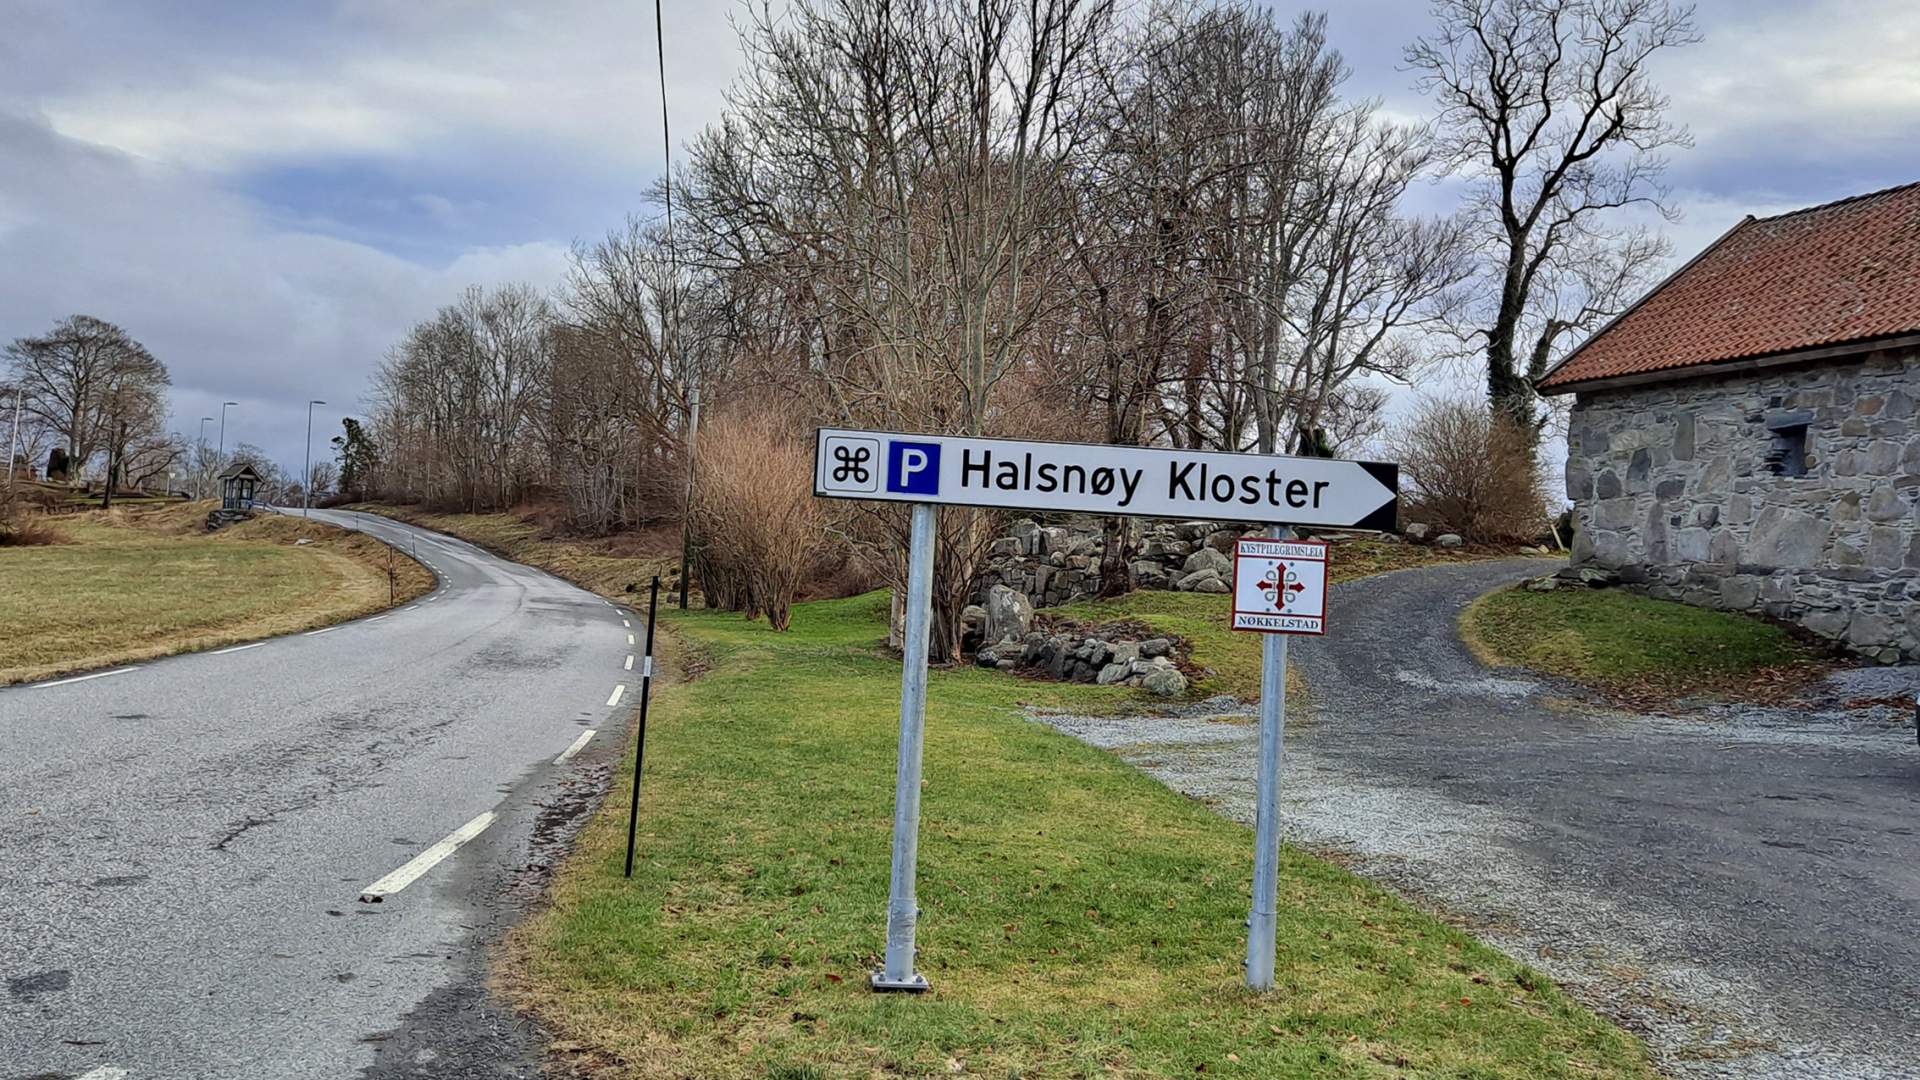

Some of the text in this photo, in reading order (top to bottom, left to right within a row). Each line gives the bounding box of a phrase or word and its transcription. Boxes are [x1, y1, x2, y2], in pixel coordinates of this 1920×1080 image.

[901, 448, 1330, 509] P Halsnøy Kloster
[1240, 543, 1323, 557] KYSTPILEGRIMSLEIA
[1238, 616, 1319, 629] NØKKELSTAD
